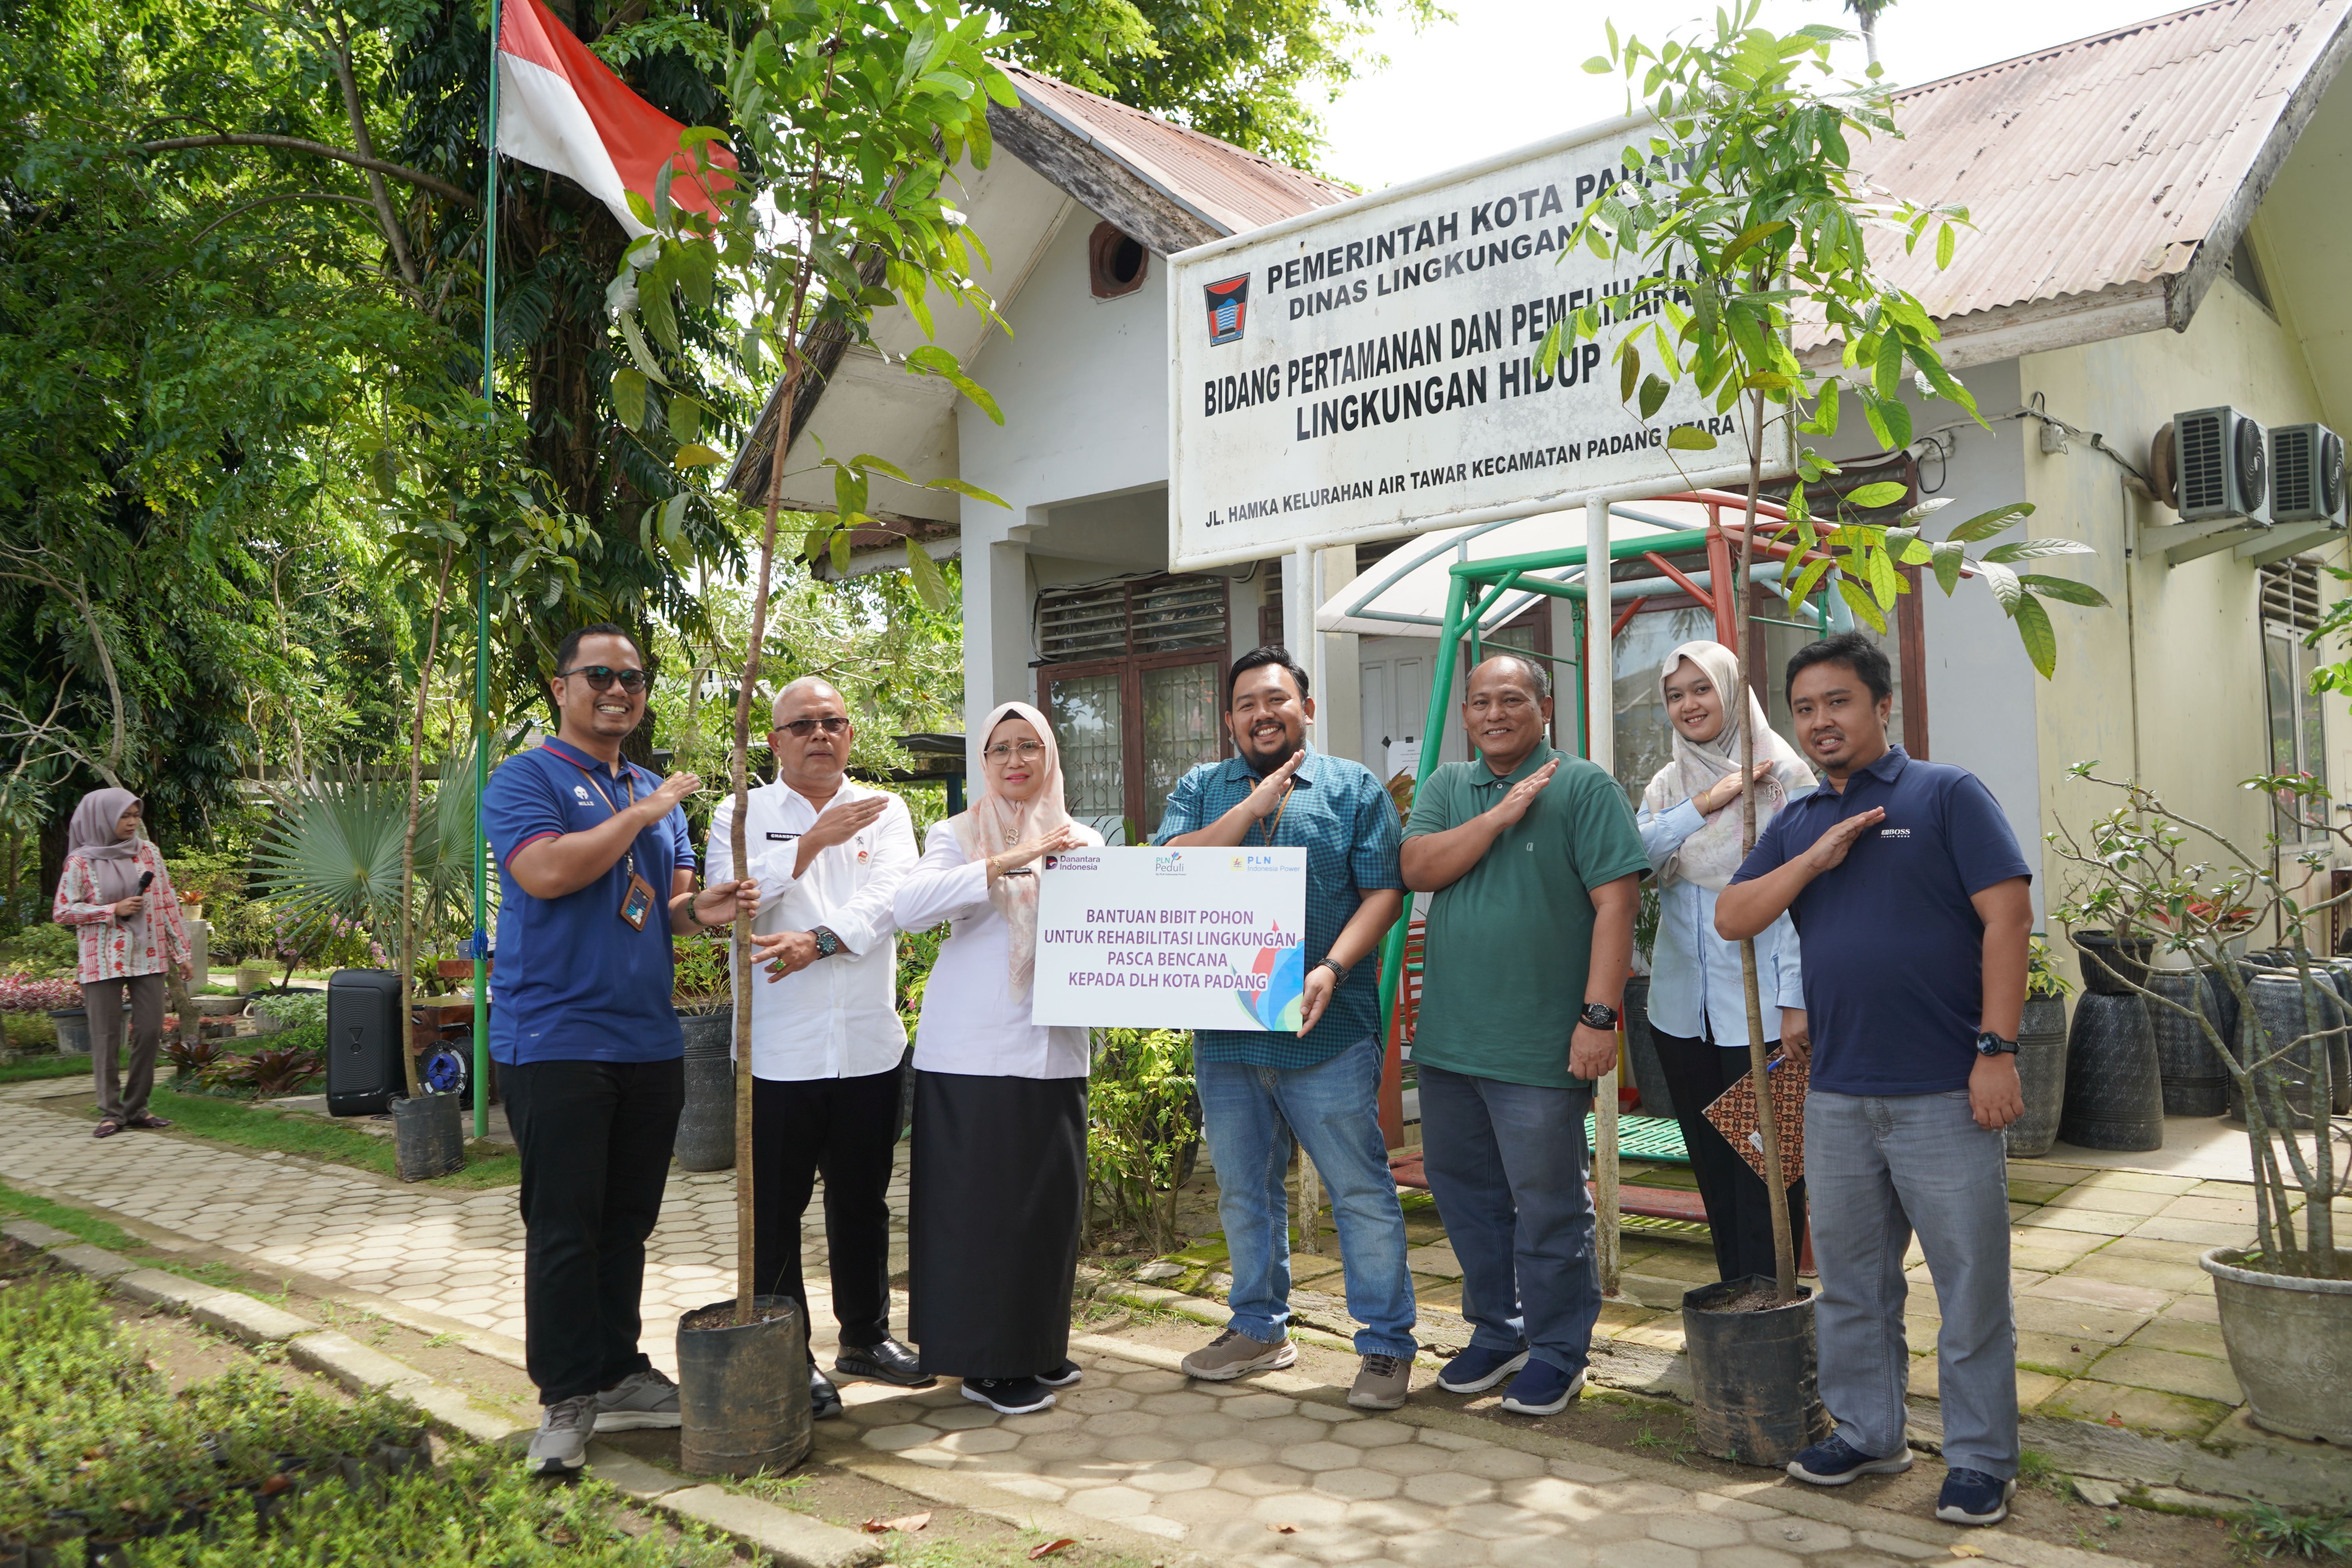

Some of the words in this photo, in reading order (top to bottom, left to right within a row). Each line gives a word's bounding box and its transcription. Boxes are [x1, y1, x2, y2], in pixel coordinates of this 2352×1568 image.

[1268, 212, 1457, 294] PEMERINTAH
[1472, 185, 1563, 236] KOTA
[1290, 279, 1367, 320] DINAS
[1378, 222, 1577, 296] LINGKUNGAN
[1205, 365, 1279, 417] BIDANG
[1288, 323, 1441, 397] PERTAMANAN
[1452, 309, 1501, 359] DAN
[1298, 366, 1487, 441] LINGKUNGAN
[1500, 343, 1600, 399] HIDUP
[1206, 510, 1224, 527] JL.
[1229, 499, 1278, 522] HAMKA
[1283, 480, 1372, 513] KELURAHAN
[1379, 475, 1405, 495] AIR
[1410, 464, 1466, 489] TAWAR
[1473, 443, 1580, 478] KECAMATAN
[1588, 428, 1661, 459] PADANG
[1669, 415, 1735, 436] ARA
[1156, 863, 1184, 872] Peduli
[1045, 930, 1094, 943] UNTUK
[1098, 931, 1192, 945] REHABILITASI
[1198, 932, 1296, 946] LINGKUNGAN
[1087, 909, 1156, 923] BANTUAN
[1160, 910, 1196, 924] BIBIT
[1201, 911, 1253, 924] POHON
[1069, 973, 1125, 986] KEPADA
[1130, 973, 1158, 987] DLH
[1163, 974, 1200, 987] KOTA
[1205, 975, 1267, 989] PADANG
[1108, 952, 1153, 965] PASCA
[1158, 953, 1227, 967] BENCANA
